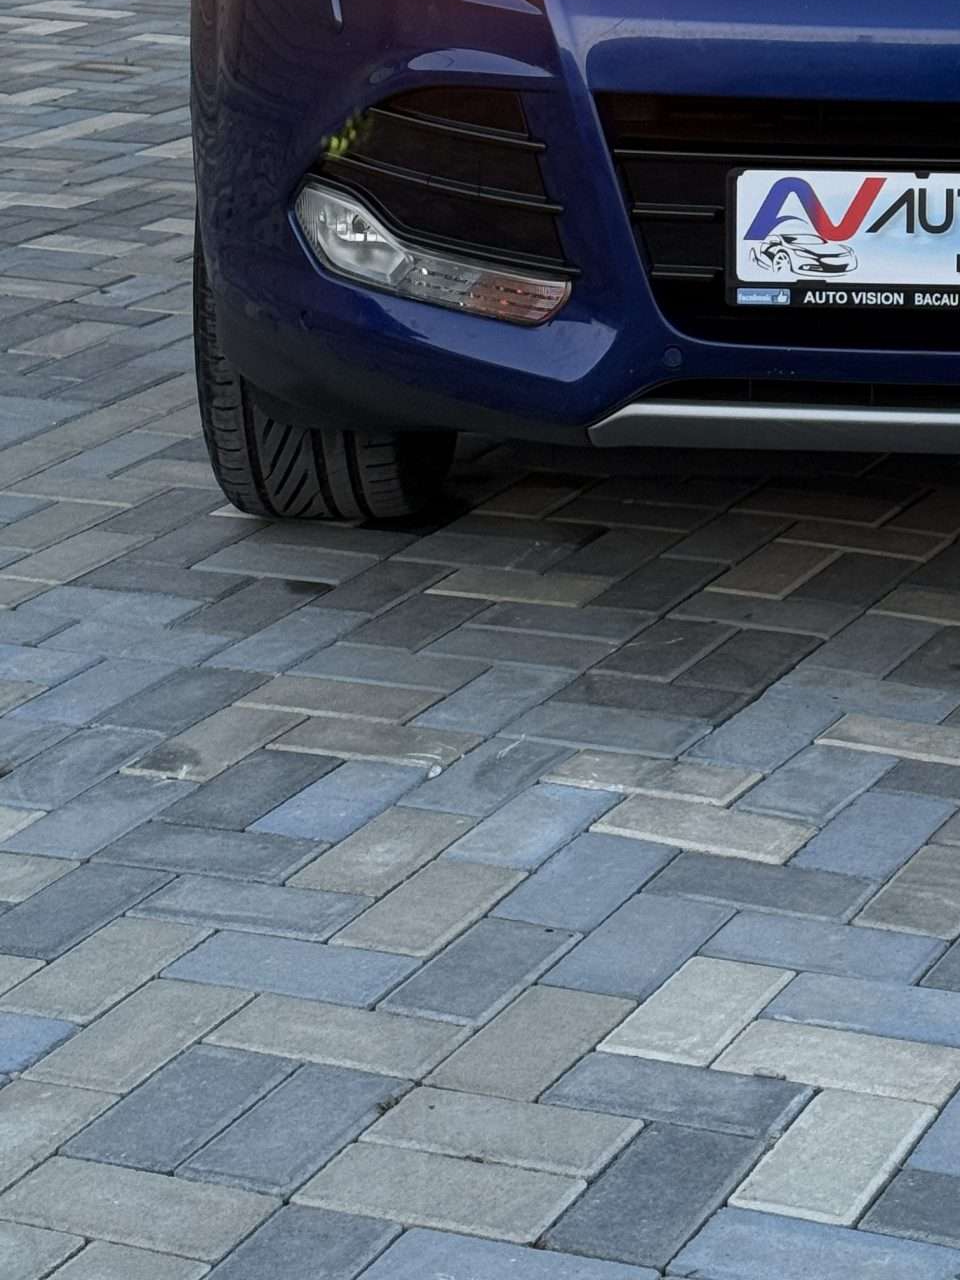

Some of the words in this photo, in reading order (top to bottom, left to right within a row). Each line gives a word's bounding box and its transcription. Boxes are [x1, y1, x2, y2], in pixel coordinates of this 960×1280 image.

[803, 291, 848, 305] AUTO
[851, 292, 905, 305] VISION
[914, 293, 960, 306] BACAU
